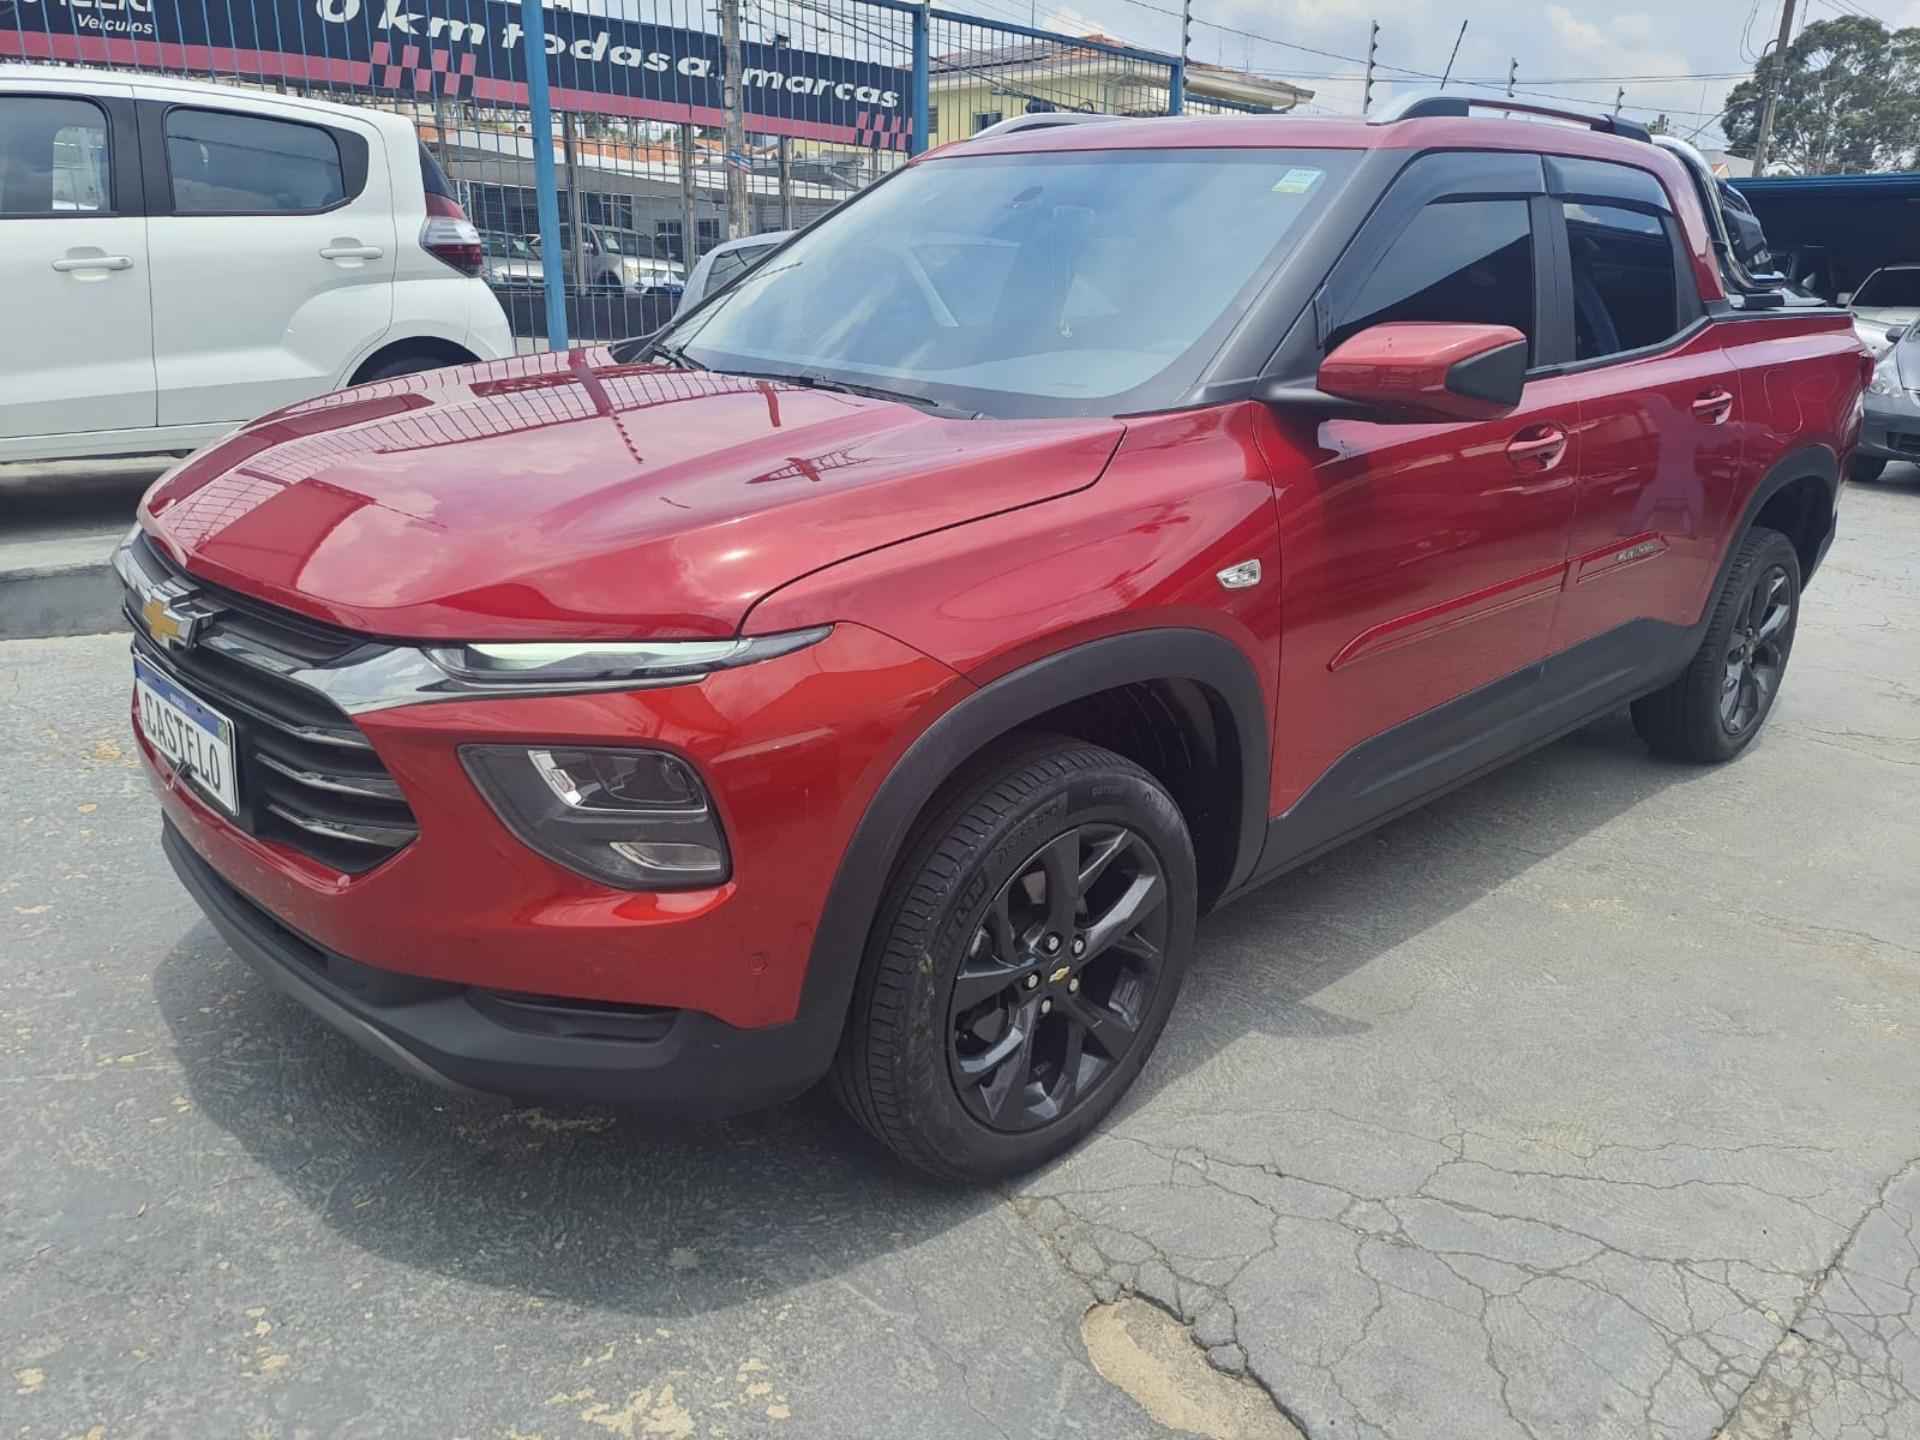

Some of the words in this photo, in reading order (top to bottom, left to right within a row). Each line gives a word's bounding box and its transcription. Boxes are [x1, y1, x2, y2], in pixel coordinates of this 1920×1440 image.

[377, 0, 486, 45] km
[742, 67, 899, 108] marcas
[144, 691, 221, 792] CASTELO
